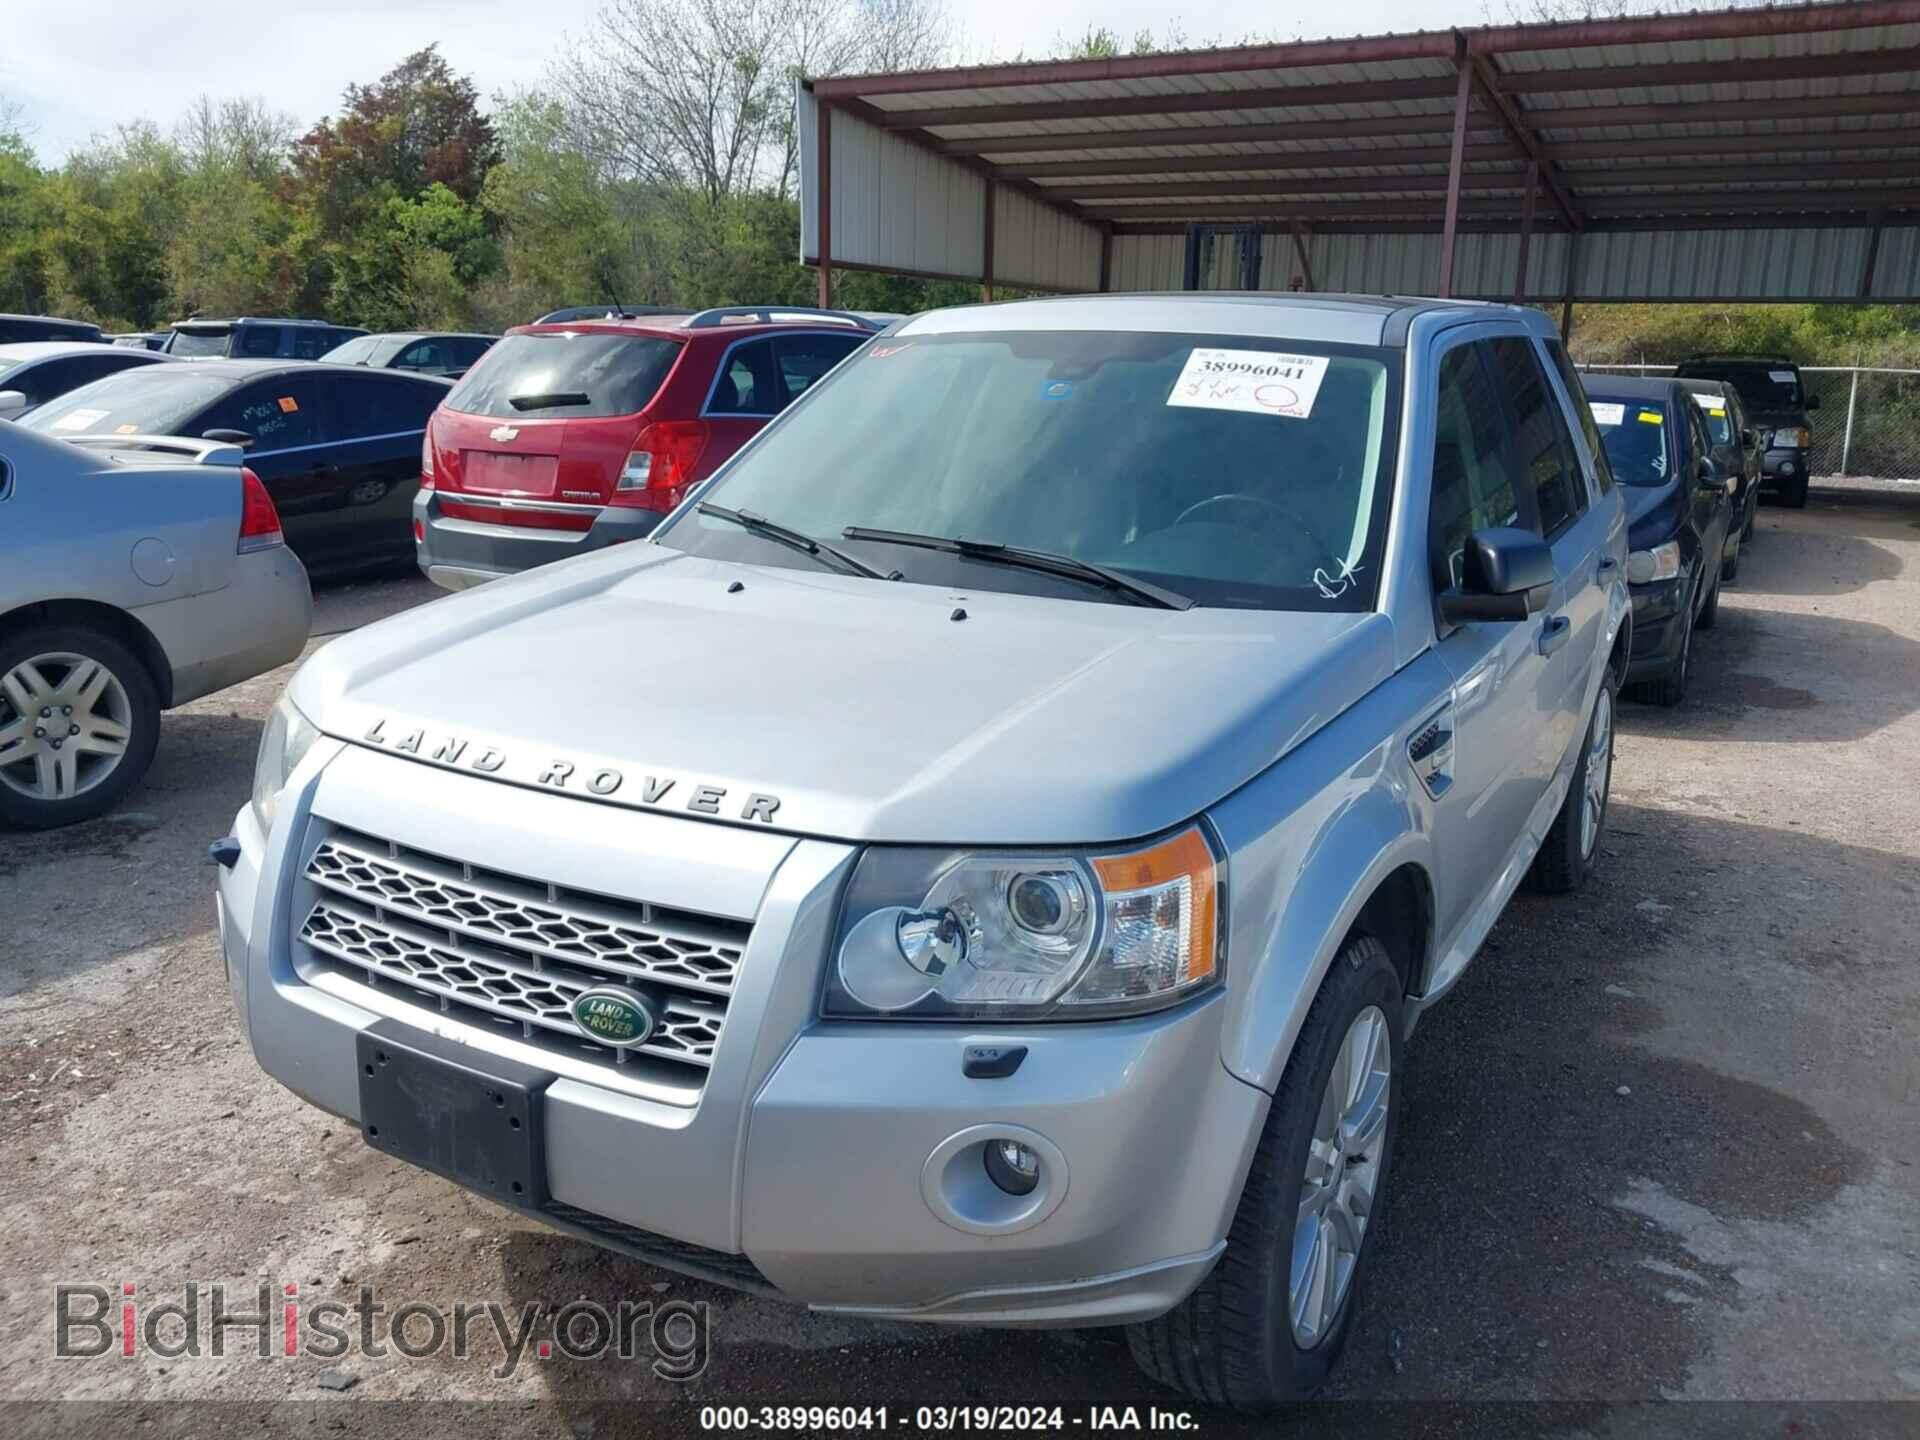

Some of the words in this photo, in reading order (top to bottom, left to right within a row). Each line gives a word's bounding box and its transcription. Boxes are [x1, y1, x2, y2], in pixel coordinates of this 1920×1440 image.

[1198, 360, 1305, 380] 38996041
[363, 718, 506, 772] LAND
[538, 758, 781, 823] ROVER
[588, 1000, 625, 1020] LAND
[590, 1014, 634, 1037] ROVER
